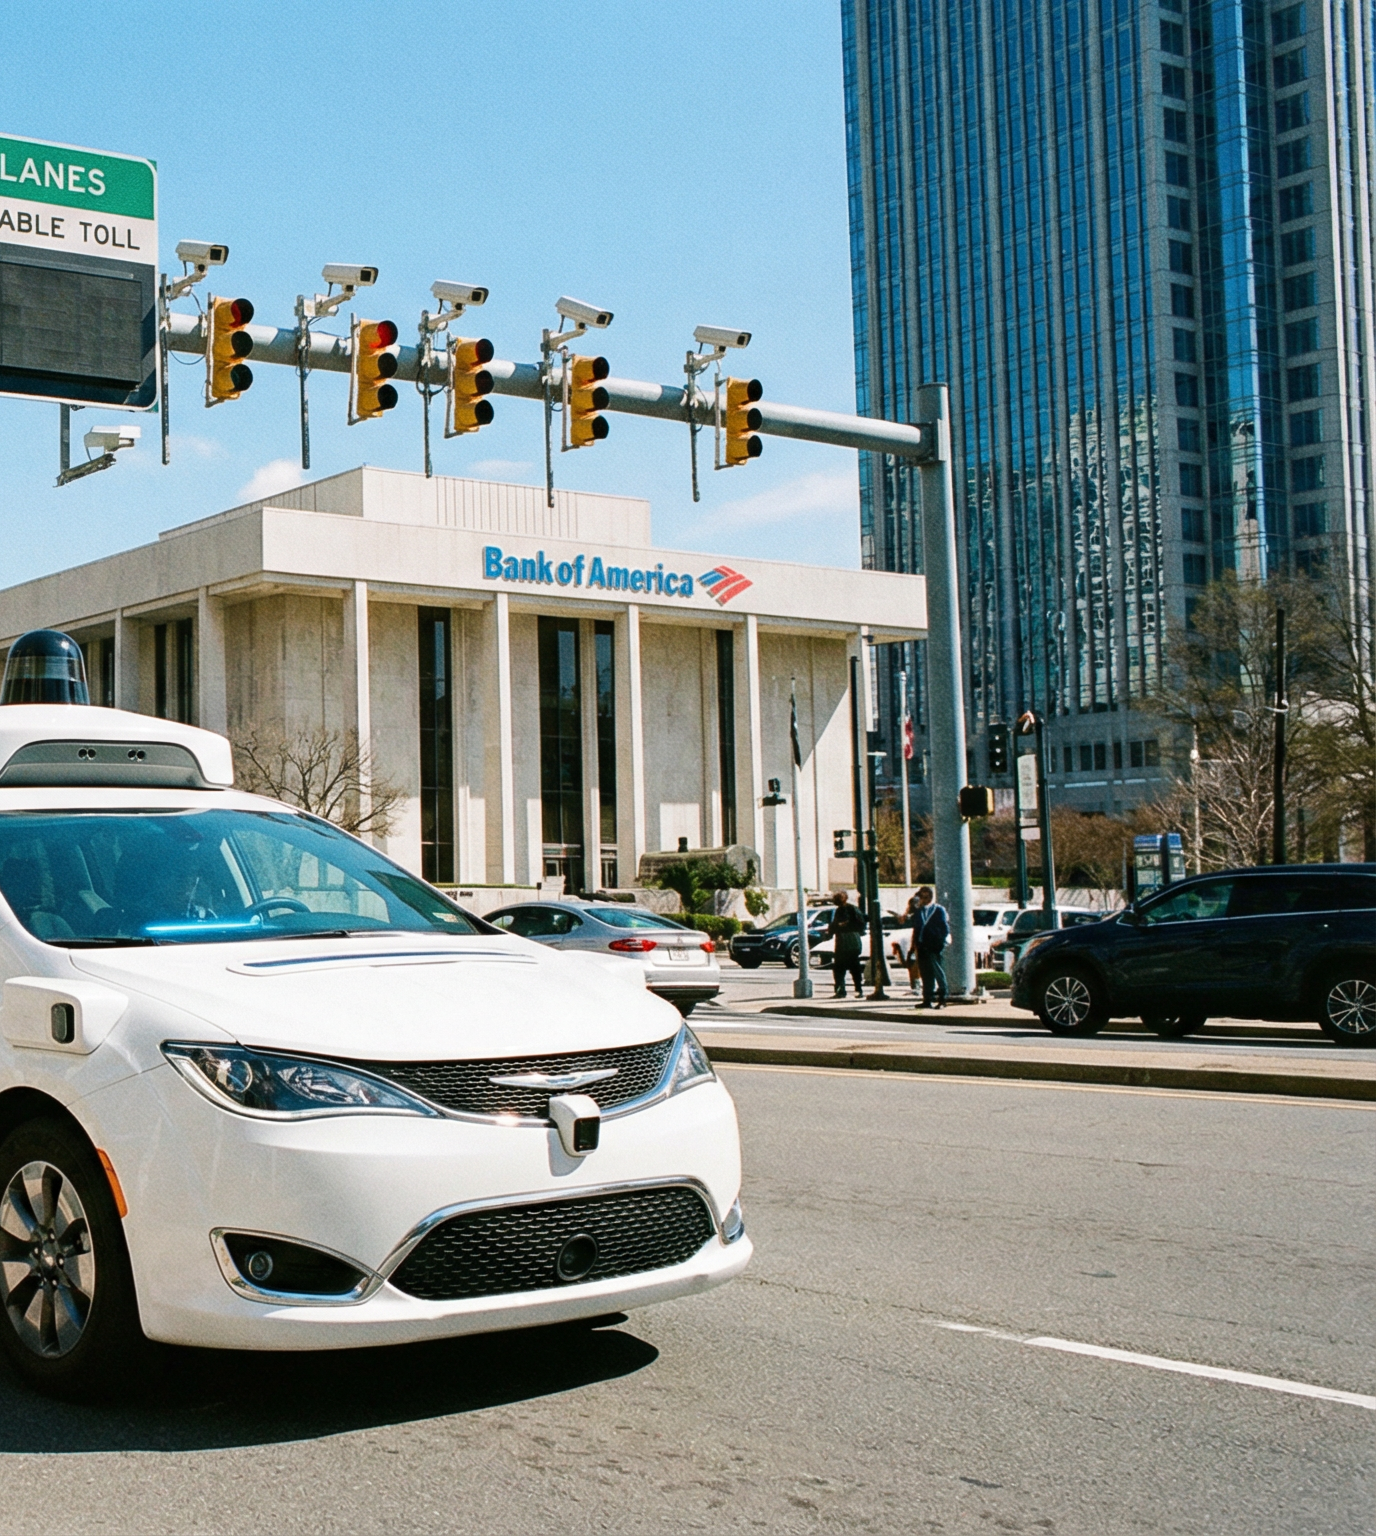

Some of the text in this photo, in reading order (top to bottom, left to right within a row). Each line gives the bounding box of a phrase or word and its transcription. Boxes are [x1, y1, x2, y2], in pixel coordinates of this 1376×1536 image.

[0, 153, 106, 196] LANES
[79, 221, 140, 251] TOLL
[482, 546, 694, 598] Bank of America
